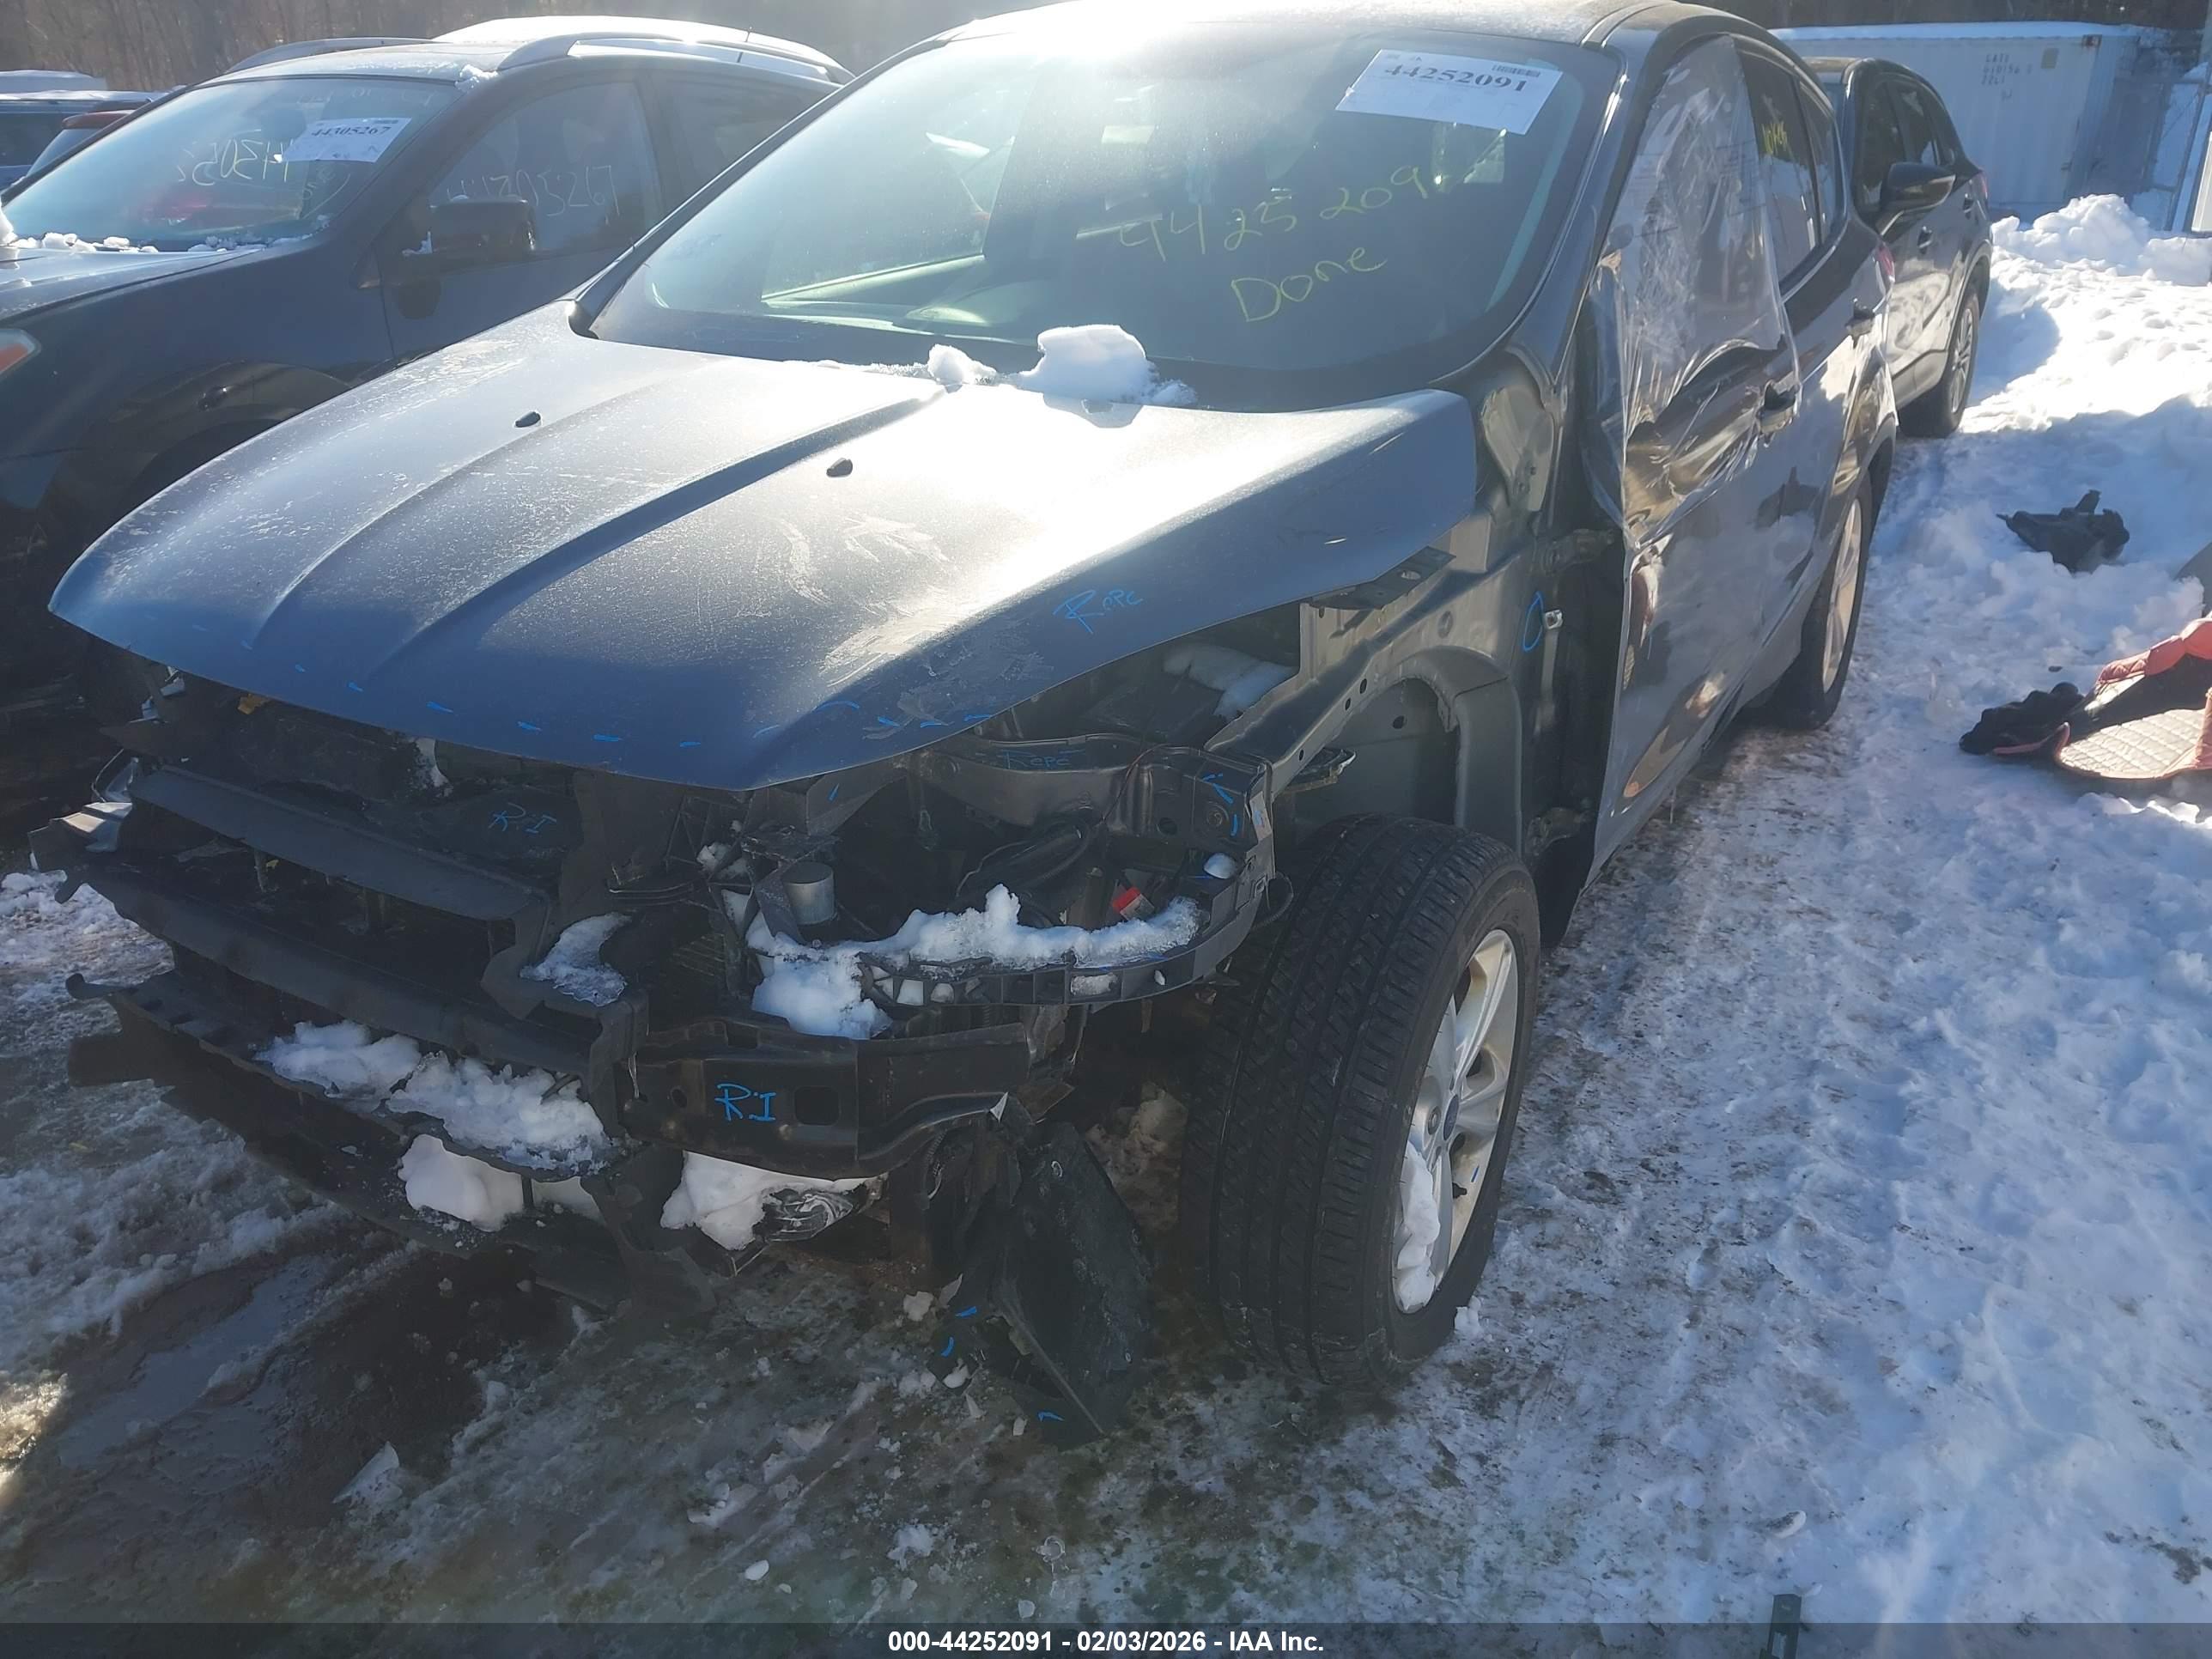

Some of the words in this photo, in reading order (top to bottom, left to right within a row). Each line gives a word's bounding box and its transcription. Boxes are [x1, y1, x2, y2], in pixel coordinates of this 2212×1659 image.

[1384, 64, 1528, 92] 44252091
[311, 126, 392, 137] 44305267
[1231, 246, 1389, 323] Done
